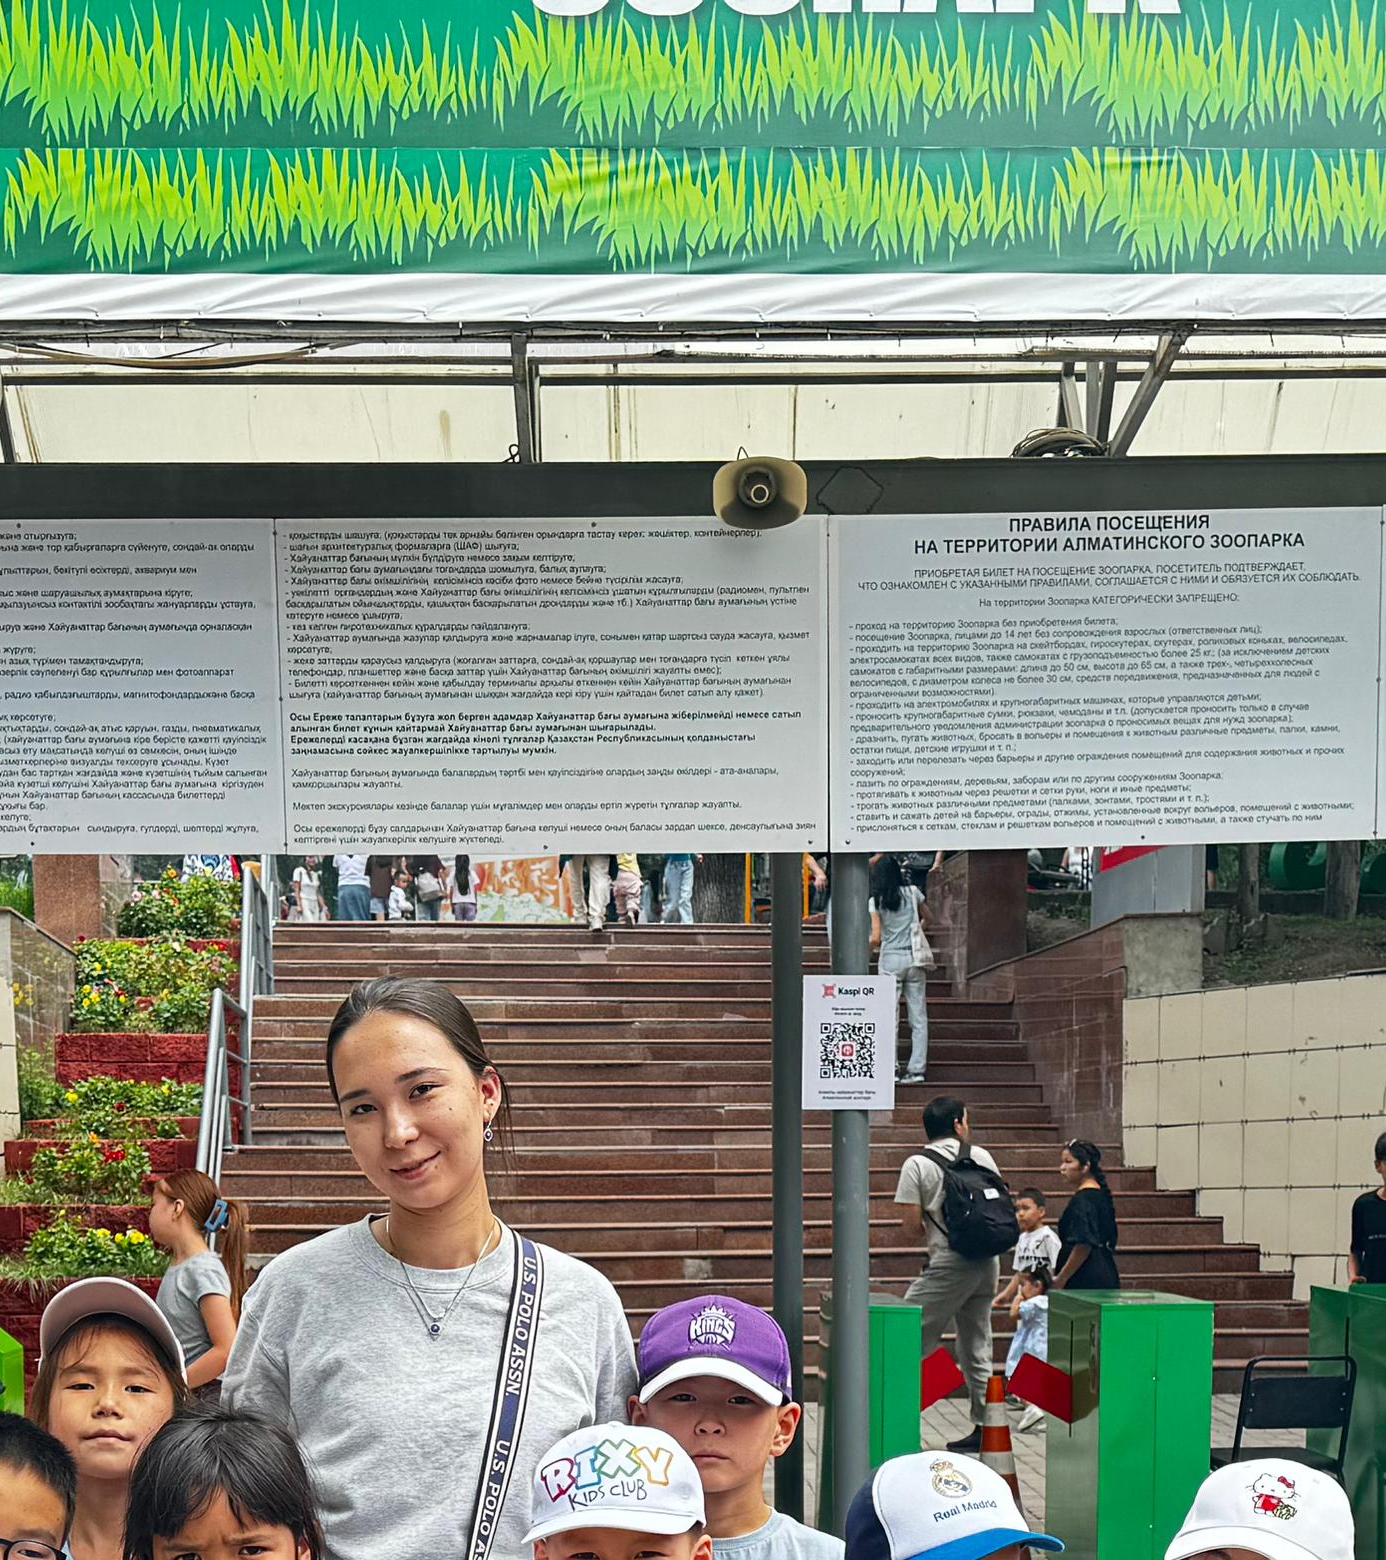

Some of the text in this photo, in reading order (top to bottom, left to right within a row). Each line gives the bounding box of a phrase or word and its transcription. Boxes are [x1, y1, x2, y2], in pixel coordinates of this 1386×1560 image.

[1009, 514, 1209, 532] ПРАВИЛА ПОСЕЩЕНИЯ
[914, 532, 1305, 554] НА ТЕРРИТОРИИ АЛМАТИНСКОГО ЗООПАРКА
[857, 581, 878, 591] ЧТО
[879, 579, 948, 591] ОЗНАКОМЛЕН
[949, 579, 957, 590] С
[958, 578, 1027, 589] УКАЗАННЫМИ
[1094, 575, 1168, 586] СОГЛАШАЕТСЯ
[1169, 575, 1178, 585] С
[1179, 575, 1209, 584] НИМИ
[1211, 574, 1218, 583] И
[1220, 572, 1280, 584] ОБЯЗУЕТСЯ
[1281, 573, 1296, 582] ИХ
[913, 567, 980, 578] ПРИОБРЕТАЯ
[982, 567, 1015, 577] БИЛЕТ
[1016, 567, 1031, 576] НА
[1031, 565, 1096, 576] ПОСЕЩЕНИЕ
[1155, 562, 1222, 574] ПОСЕТИТЕЛЬ
[838, 987, 874, 997] Kaspi QR
[505, 1256, 537, 1398] U.S. POLO ASSN.
[689, 1314, 736, 1342] KINGS
[491, 1440, 511, 1481] U.S.
[540, 1439, 674, 1502] RIXY
[568, 1479, 647, 1511] KIDS CLUB
[479, 1483, 503, 1536] POLO
[933, 1500, 997, 1522] Real Madrid
